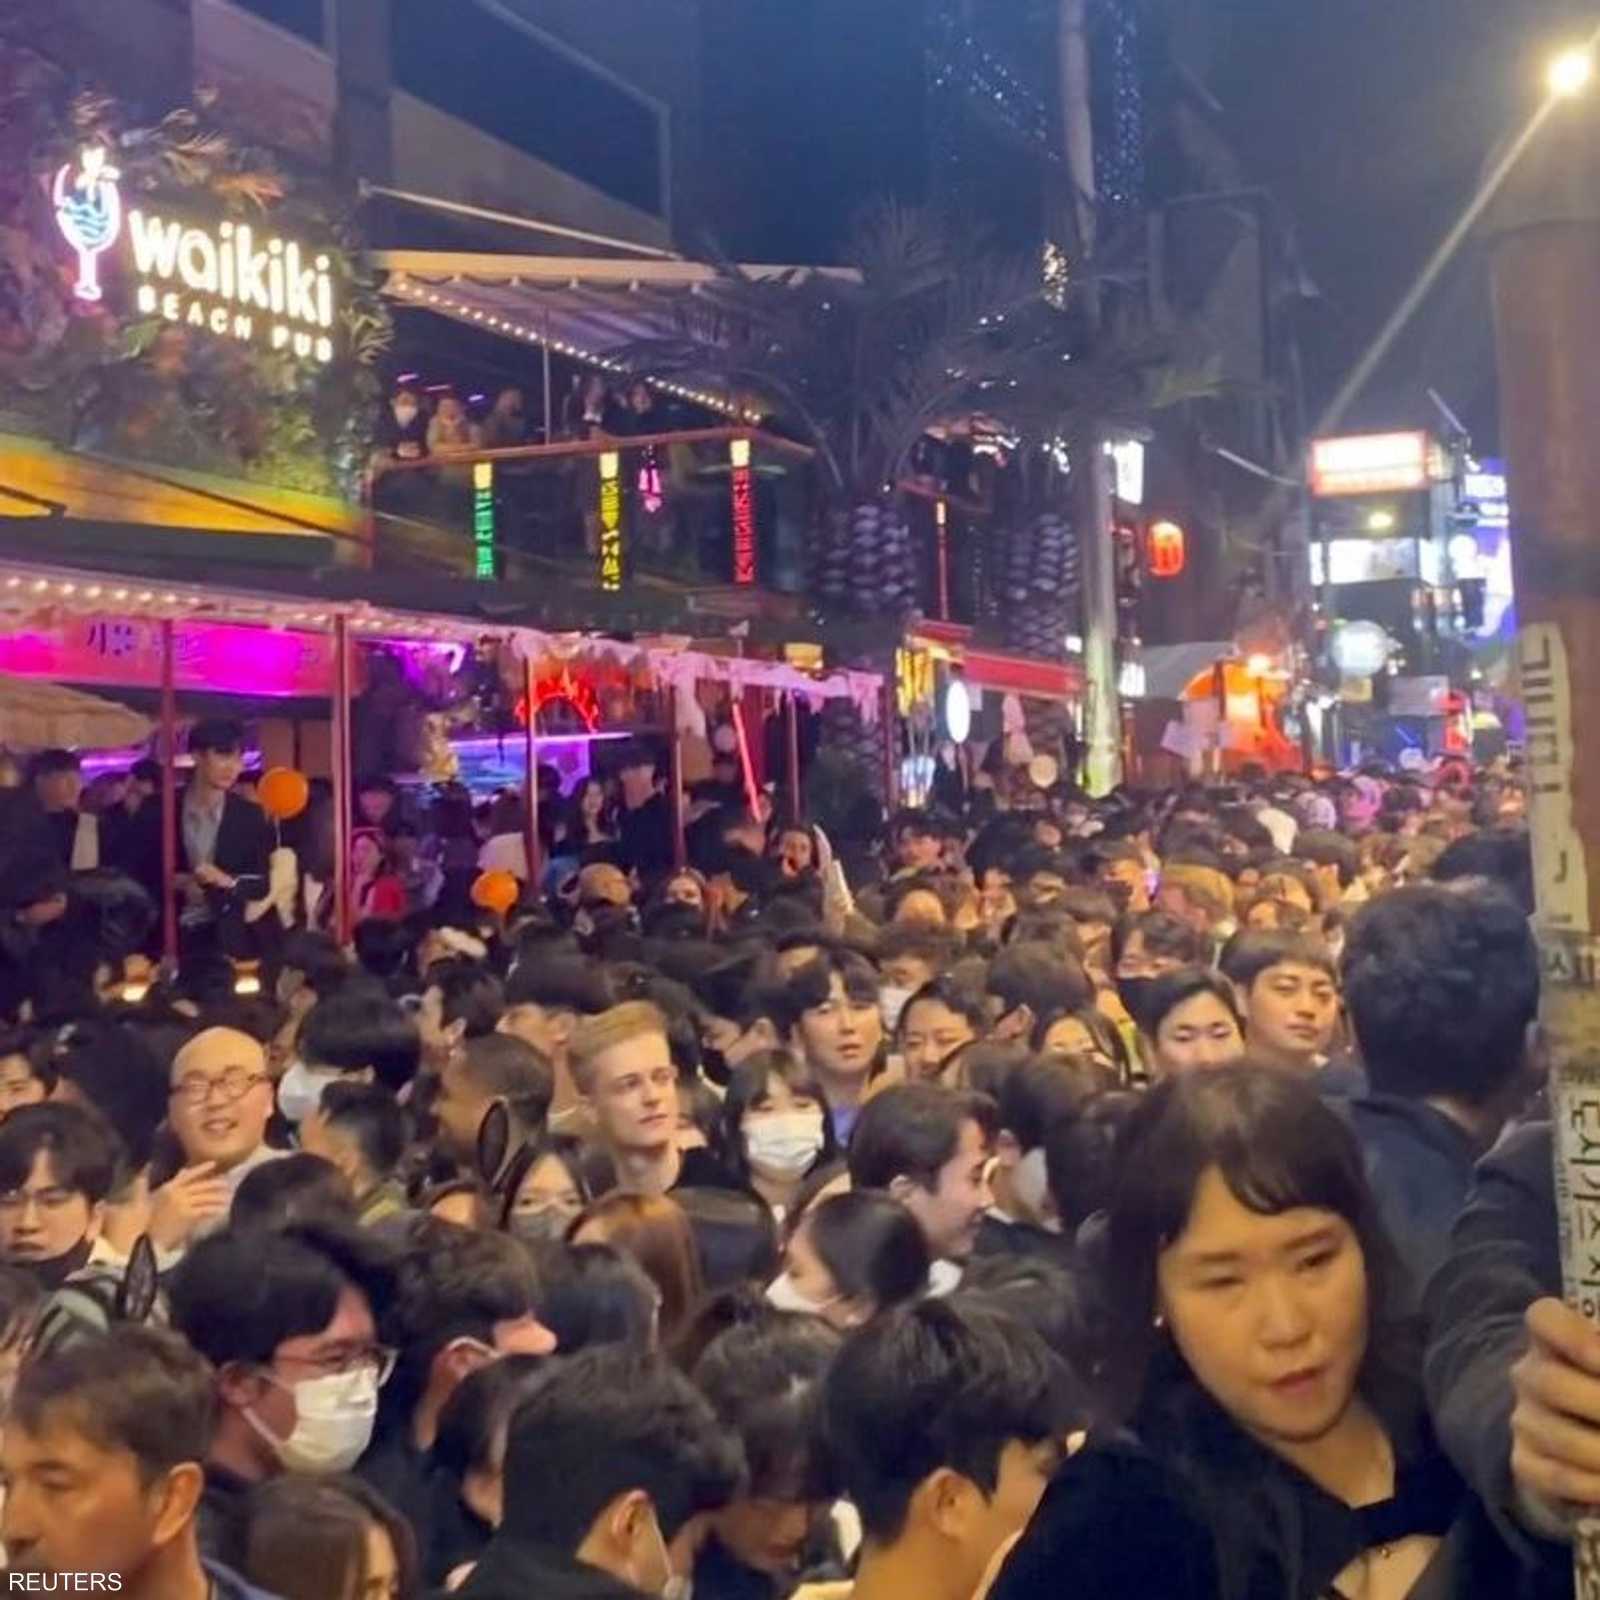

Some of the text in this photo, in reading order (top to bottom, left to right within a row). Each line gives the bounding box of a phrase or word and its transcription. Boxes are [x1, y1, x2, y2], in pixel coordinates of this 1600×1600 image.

[128, 209, 333, 328] waikiki
[137, 284, 332, 363] BEACH PUB
